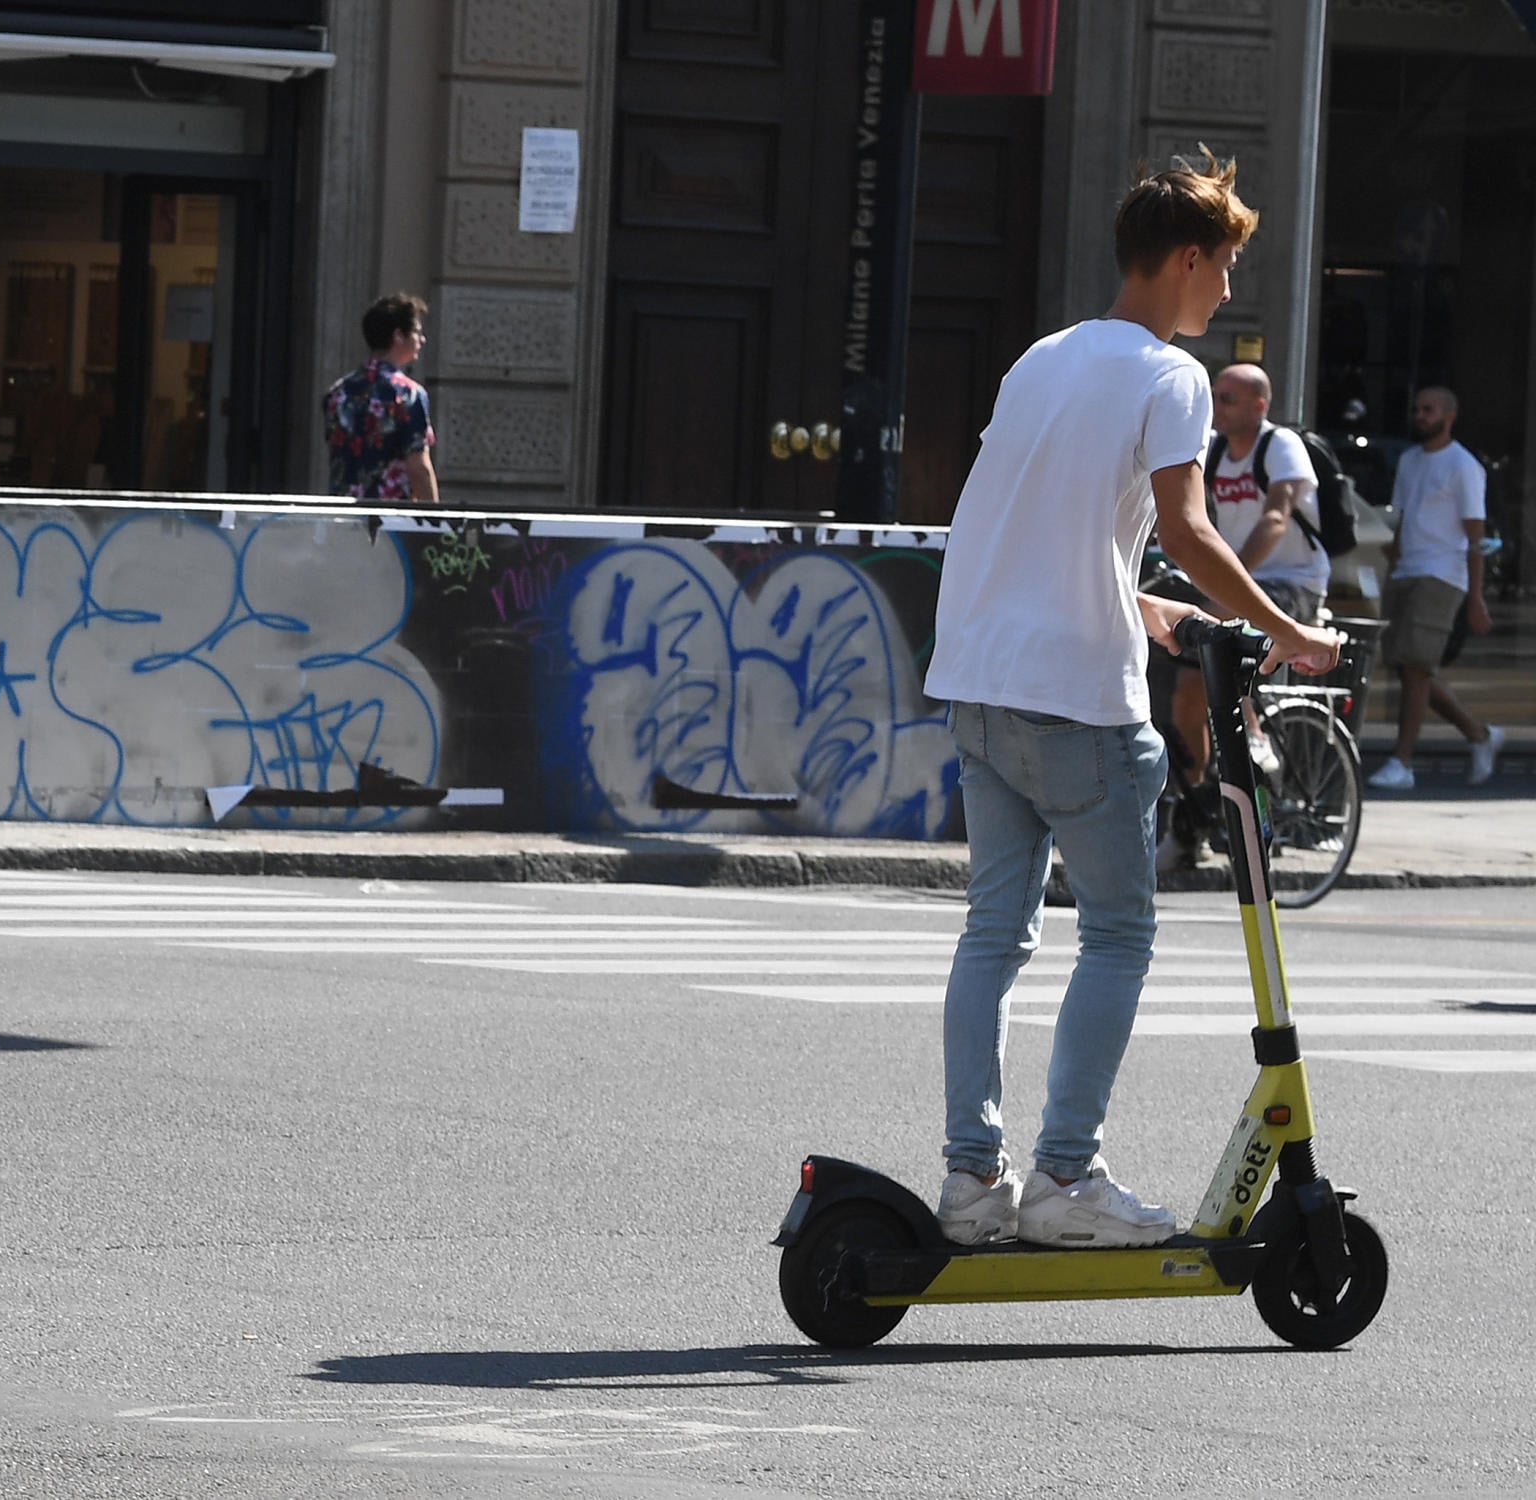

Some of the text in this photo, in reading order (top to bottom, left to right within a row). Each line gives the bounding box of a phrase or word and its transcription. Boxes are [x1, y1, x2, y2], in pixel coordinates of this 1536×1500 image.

[925, 0, 1023, 57] M
[845, 17, 885, 373] Milano Porta Venezia
[1235, 1140, 1272, 1205] dott
